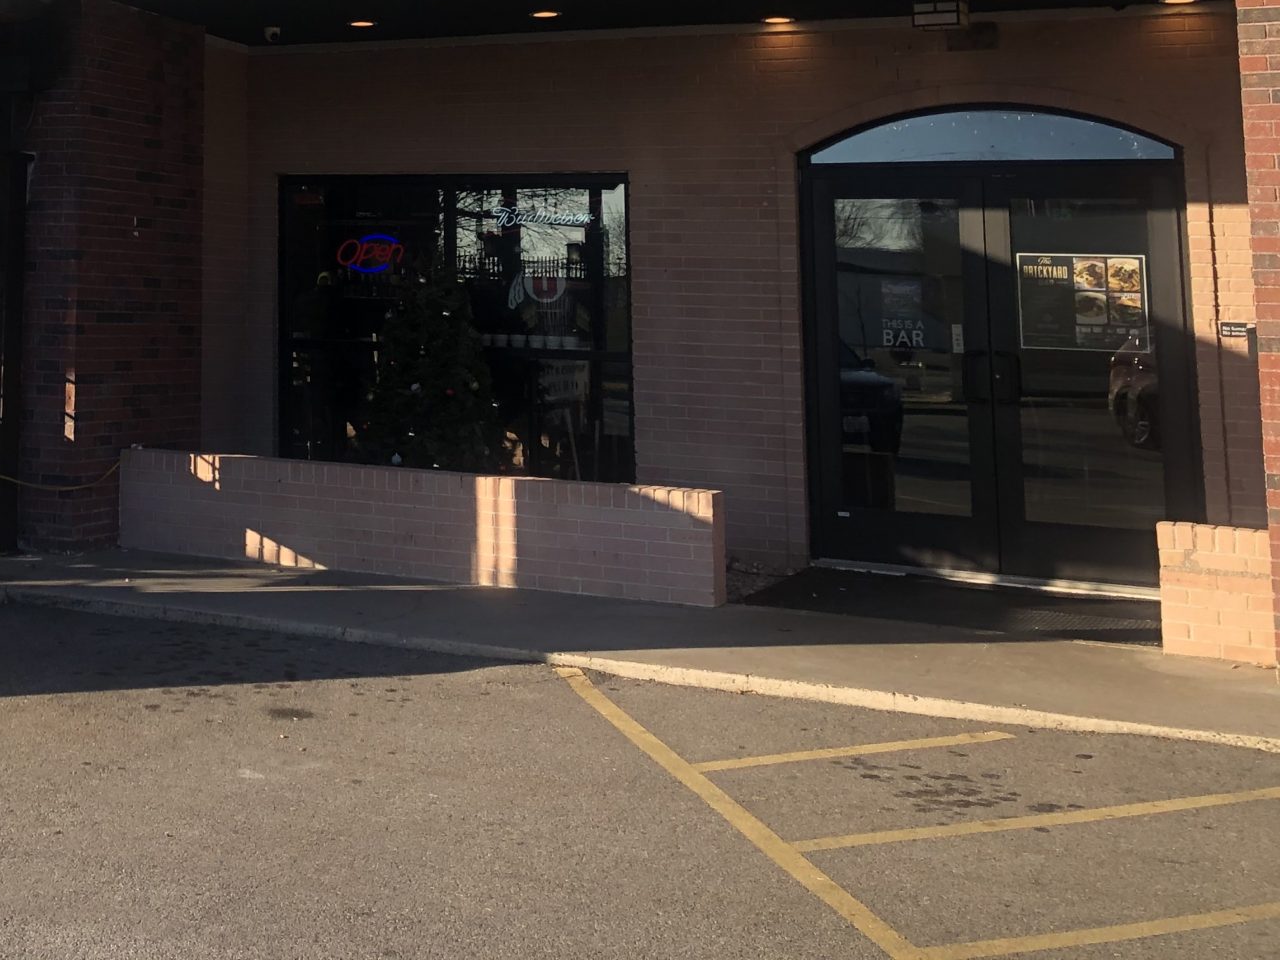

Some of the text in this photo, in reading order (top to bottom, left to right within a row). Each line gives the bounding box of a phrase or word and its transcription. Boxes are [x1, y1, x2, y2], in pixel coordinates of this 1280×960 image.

[492, 206, 596, 228] Budweiser
[1023, 265, 1068, 280] BRICKYARD
[882, 319, 925, 329] THIS IS A
[882, 329, 925, 347] BAR
